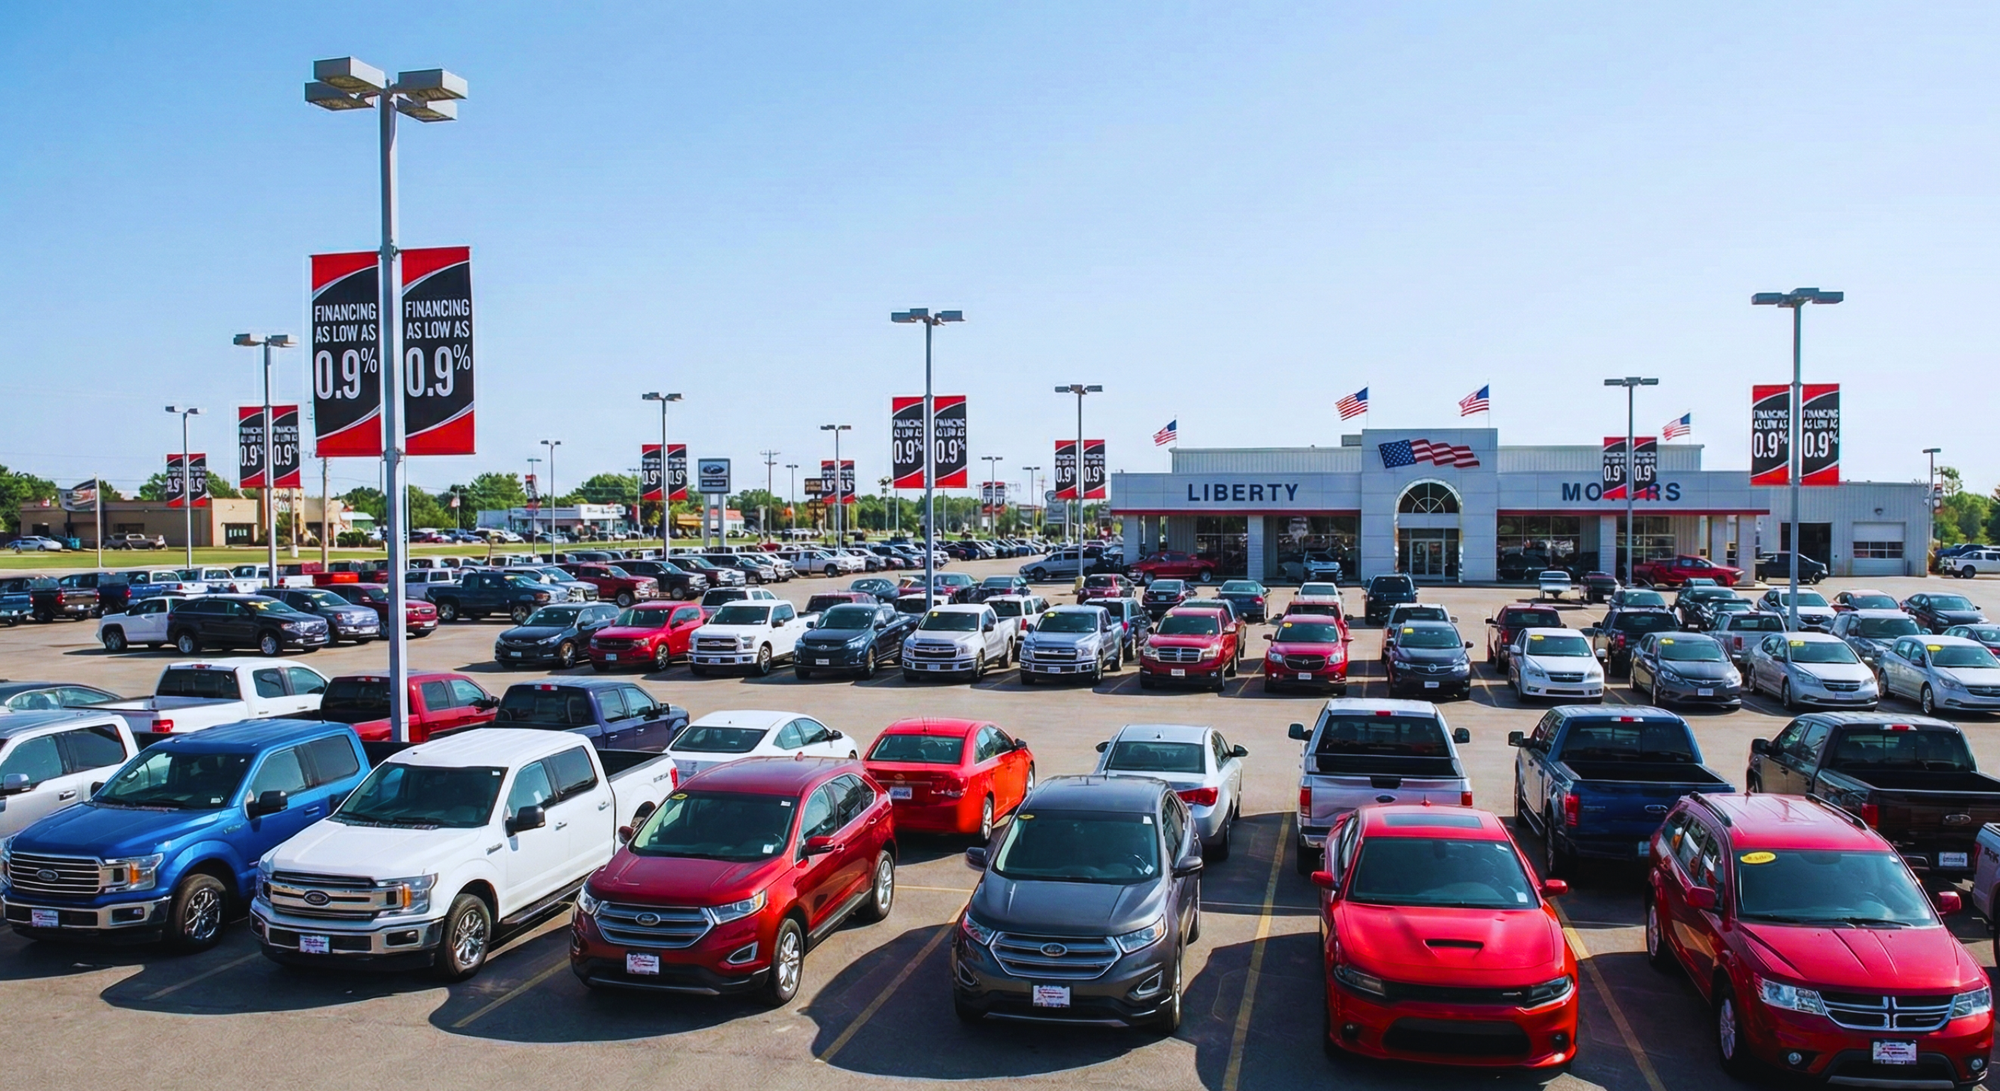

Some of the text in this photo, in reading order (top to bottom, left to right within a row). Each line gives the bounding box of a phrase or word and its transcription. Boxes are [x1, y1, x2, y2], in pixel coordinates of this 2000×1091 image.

[315, 303, 376, 322] FINANCING
[405, 298, 470, 318] FINANCING
[315, 323, 376, 343] AS LOW AS
[406, 320, 470, 339] AS LOW AS
[315, 347, 378, 400] 0.9%
[405, 344, 471, 398] 0.9%
[894, 438, 924, 464] 0.9%
[935, 438, 966, 464] 0.9%
[1753, 430, 1788, 458] 0.9%
[1803, 430, 1839, 458] 0.9%
[1187, 482, 1682, 501] LIBERTY MORS
